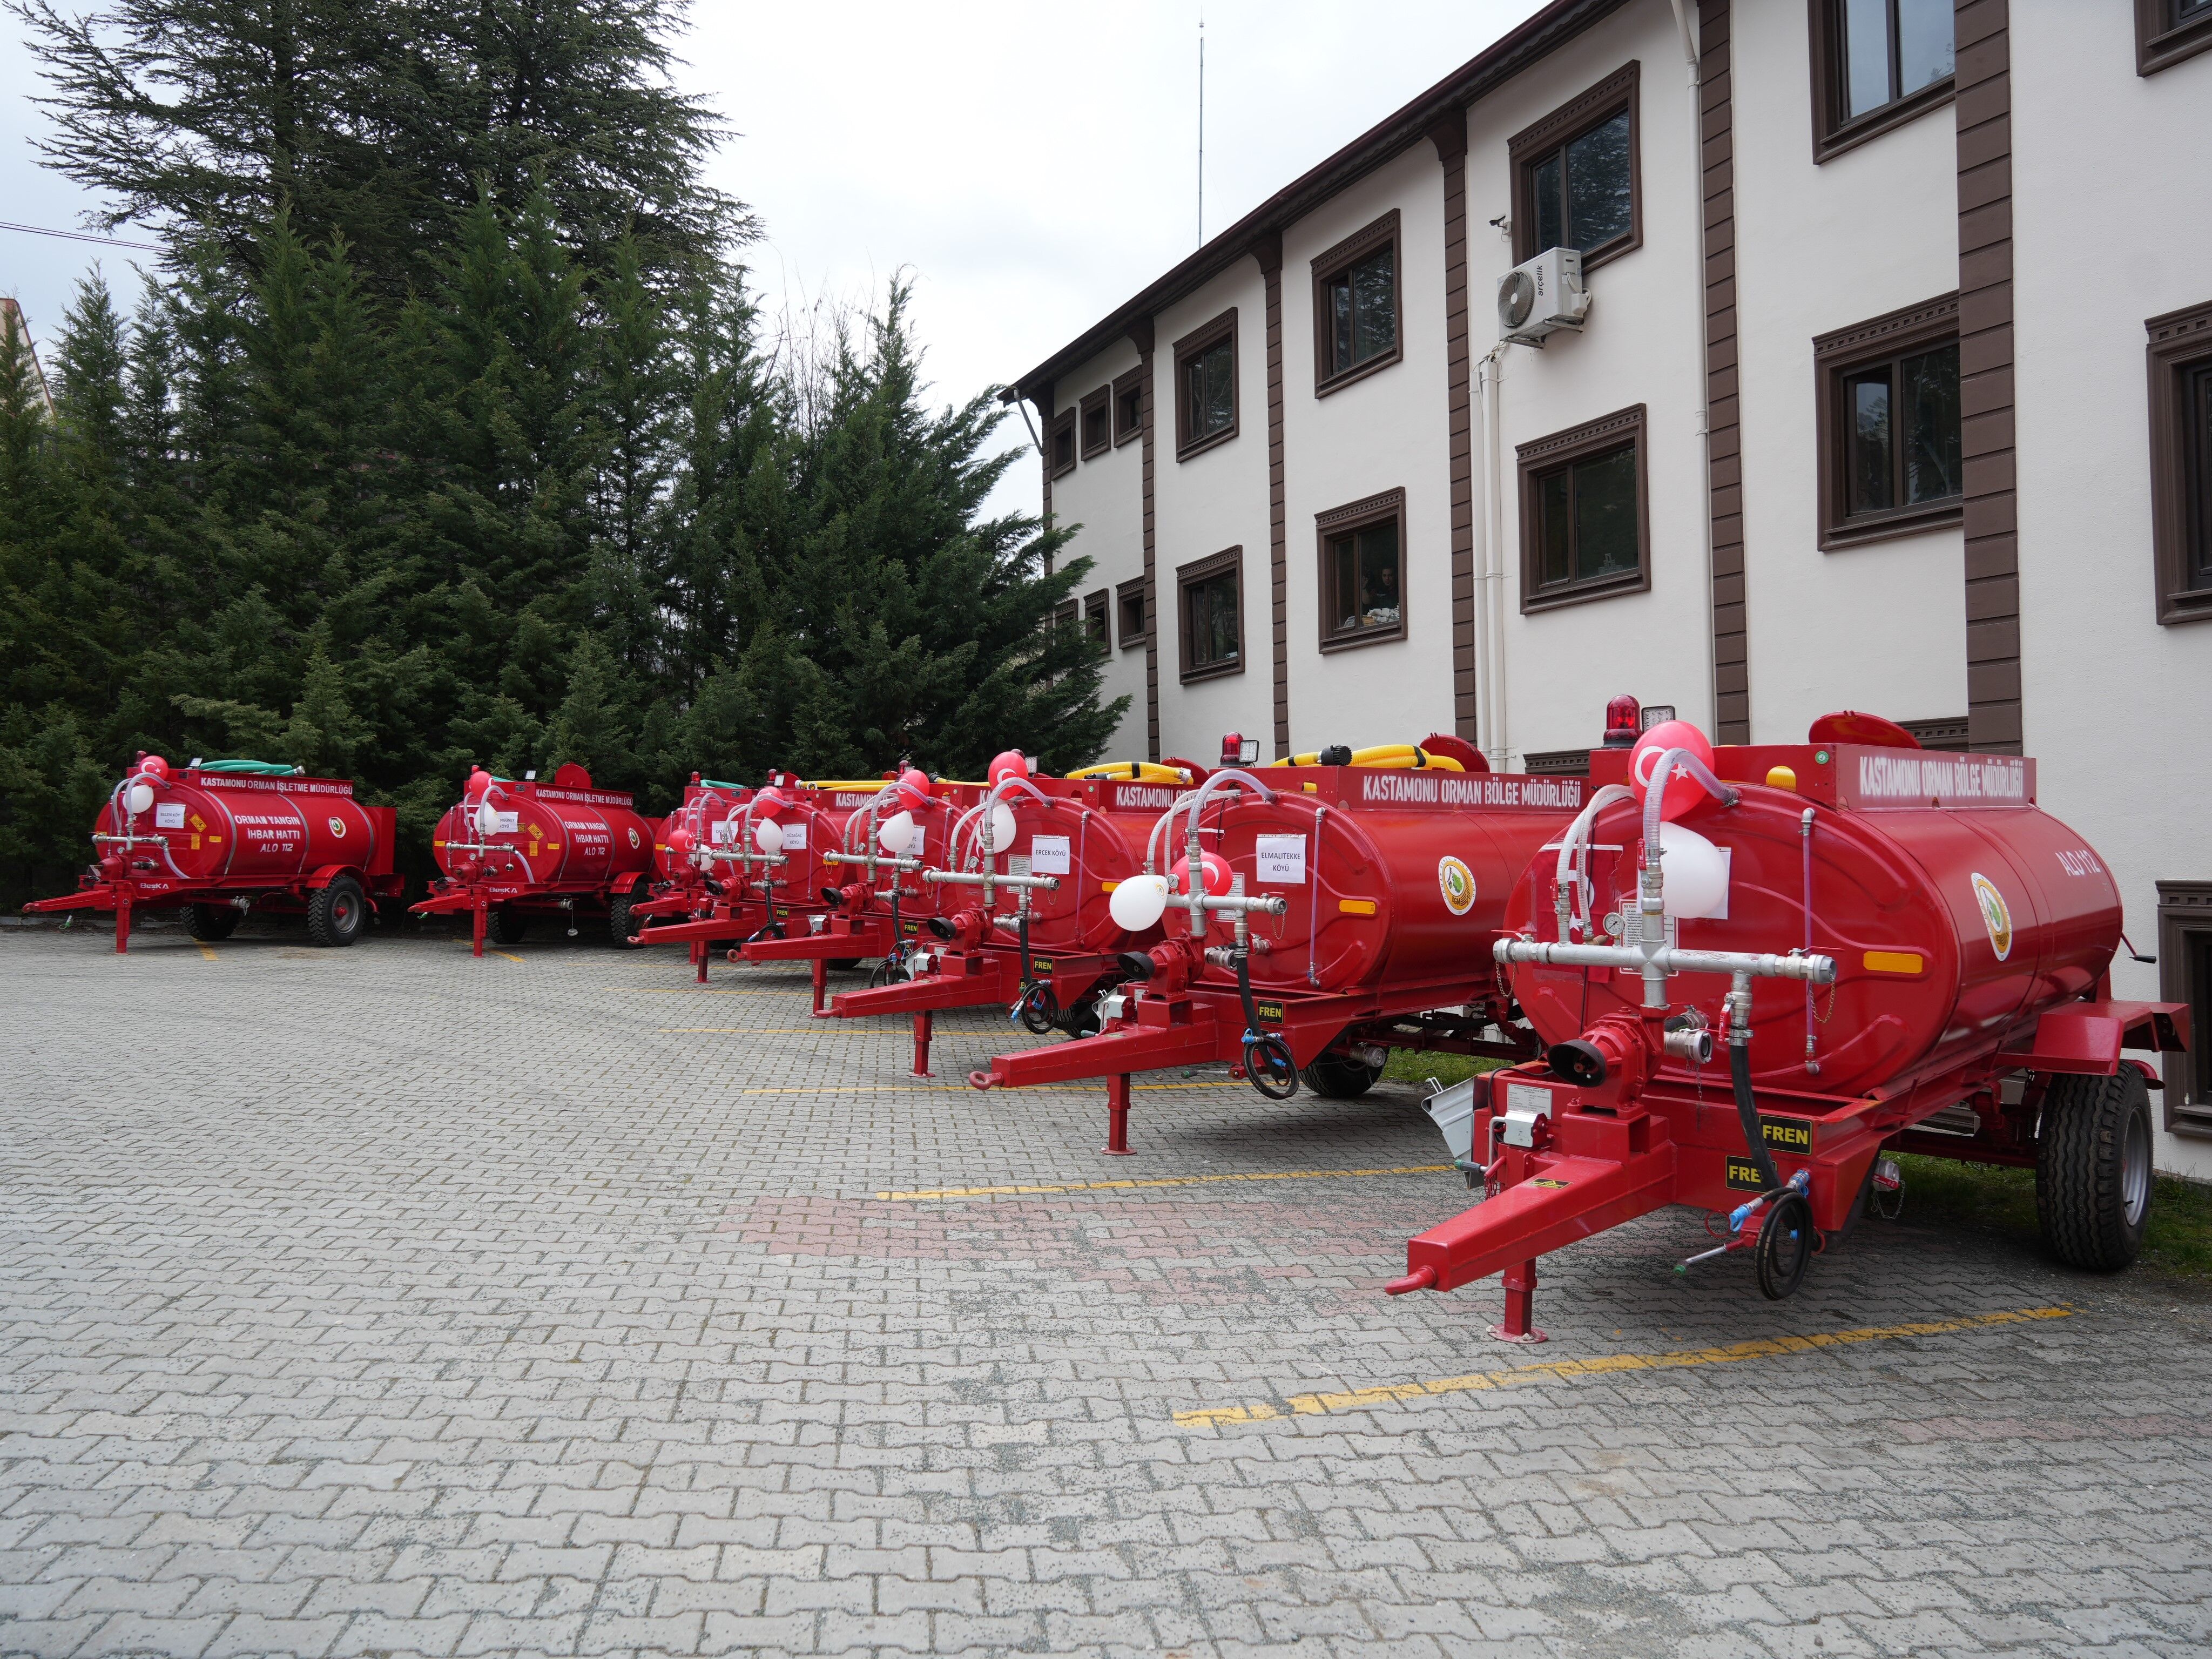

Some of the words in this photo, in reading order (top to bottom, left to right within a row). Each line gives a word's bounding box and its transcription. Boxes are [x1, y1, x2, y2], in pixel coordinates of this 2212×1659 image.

[1536, 265, 1545, 296] arçelik
[1860, 756, 1920, 796] KASTAMONU
[1921, 760, 1954, 796] ORMAN
[1954, 757, 1981, 796] BÖLGE
[1981, 758, 2023, 797] MÜDÜRLÜĞÜ
[201, 777, 246, 787] KASTAMONU
[248, 781, 275, 790] ORMAN
[277, 780, 308, 792] İŞLETME
[310, 783, 353, 794] MÜDÜRLÜĞÜ
[1363, 775, 1438, 802] KASTAMONU
[1441, 779, 1481, 804] ORMAN
[1485, 777, 1519, 805] BÖLGE
[1521, 779, 1581, 807] MÜDÜRLÜĞÜ
[536, 789, 565, 799] KASTAMONU
[567, 792, 584, 801] ORMAN
[585, 792, 604, 804] İŞLETME
[606, 795, 633, 806] MÜDÜRLÜĞÜ
[1116, 786, 1173, 807] KASTAMONU
[234, 815, 268, 824] ORMAN
[268, 816, 300, 825] YANGIN
[564, 821, 585, 830] ORMAN
[585, 822, 607, 831] YANGIN
[247, 828, 274, 839] İHBAR
[276, 830, 300, 839] HATTI
[575, 833, 593, 843] İHBAR
[594, 835, 609, 843] HATTI
[260, 843, 278, 852] ALO
[282, 843, 293, 852] 112
[584, 847, 596, 855] ALO
[1273, 864, 1289, 872] KÖYÜ
[2055, 851, 2085, 876] ALO
[2074, 850, 2101, 873] 112
[1035, 961, 1051, 970] FREN
[1259, 1006, 1282, 1017] FREN
[1762, 1124, 1808, 1145] FREN
[1729, 1165, 1761, 1183] FRE
